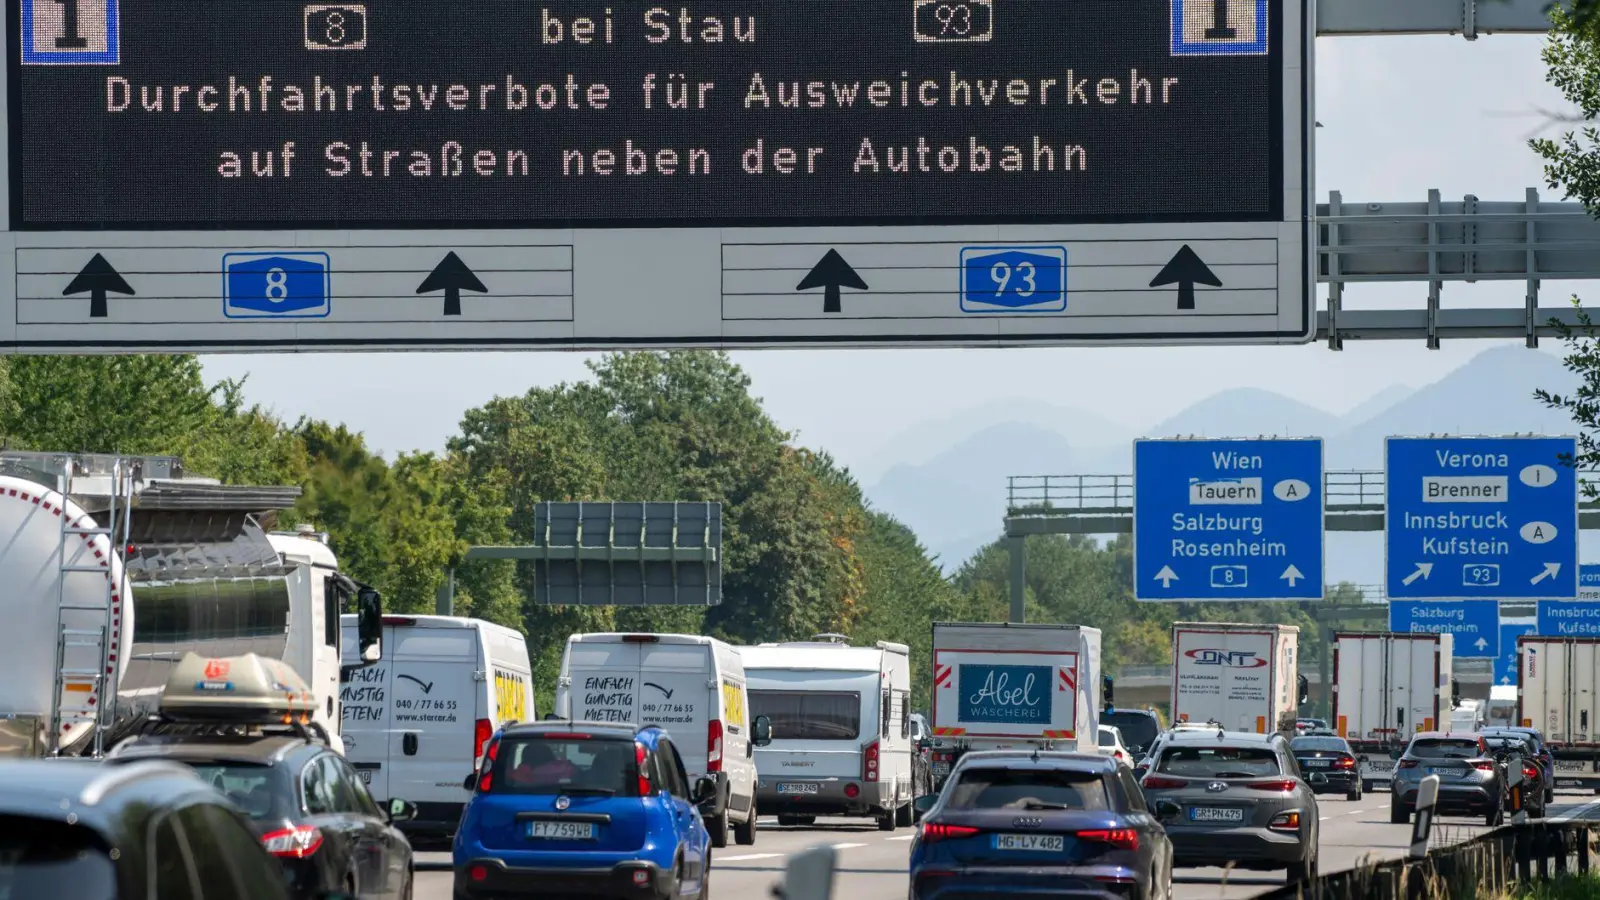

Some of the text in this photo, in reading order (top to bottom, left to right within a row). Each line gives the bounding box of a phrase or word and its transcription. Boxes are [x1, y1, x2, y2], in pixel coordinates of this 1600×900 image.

[325, 12, 346, 43] 8
[541, 7, 755, 44] bei Stau
[935, 4, 972, 35] 93
[106, 69, 1179, 112] Durchfahrtsverbote für Ausweichverkehr
[217, 135, 1087, 177] auf Straßen neben der Autobahn
[265, 267, 288, 303] 8
[990, 261, 1036, 297] 93
[1212, 451, 1262, 470] Wien
[1436, 450, 1509, 468] Verona
[1196, 484, 1297, 499] Tauern A
[1428, 482, 1502, 498] Brenner
[1172, 513, 1263, 535] Salzburg
[1405, 511, 1509, 529] Innsbruck
[1533, 525, 1545, 540] A
[1172, 538, 1286, 557] Rosenheim
[1423, 537, 1509, 555] Kufstein
[1225, 570, 1234, 583] 8
[1472, 568, 1491, 582] 93
[1411, 606, 1465, 620] Salzburg
[970, 669, 1040, 706] Abel
[342, 705, 384, 721] ETEN!
[395, 699, 412, 709] 040
[421, 700, 431, 709] 77
[434, 700, 445, 709] 66
[447, 700, 457, 709] 55
[642, 704, 656, 712] 040
[663, 704, 673, 712] 77
[674, 704, 683, 712] 66
[685, 704, 694, 712] 55
[971, 707, 1040, 718] WÄSCHEREI
[584, 708, 632, 722] MIETEN!
[1195, 808, 1242, 819] GR PN 475
[999, 835, 1062, 850] HG LY 482
